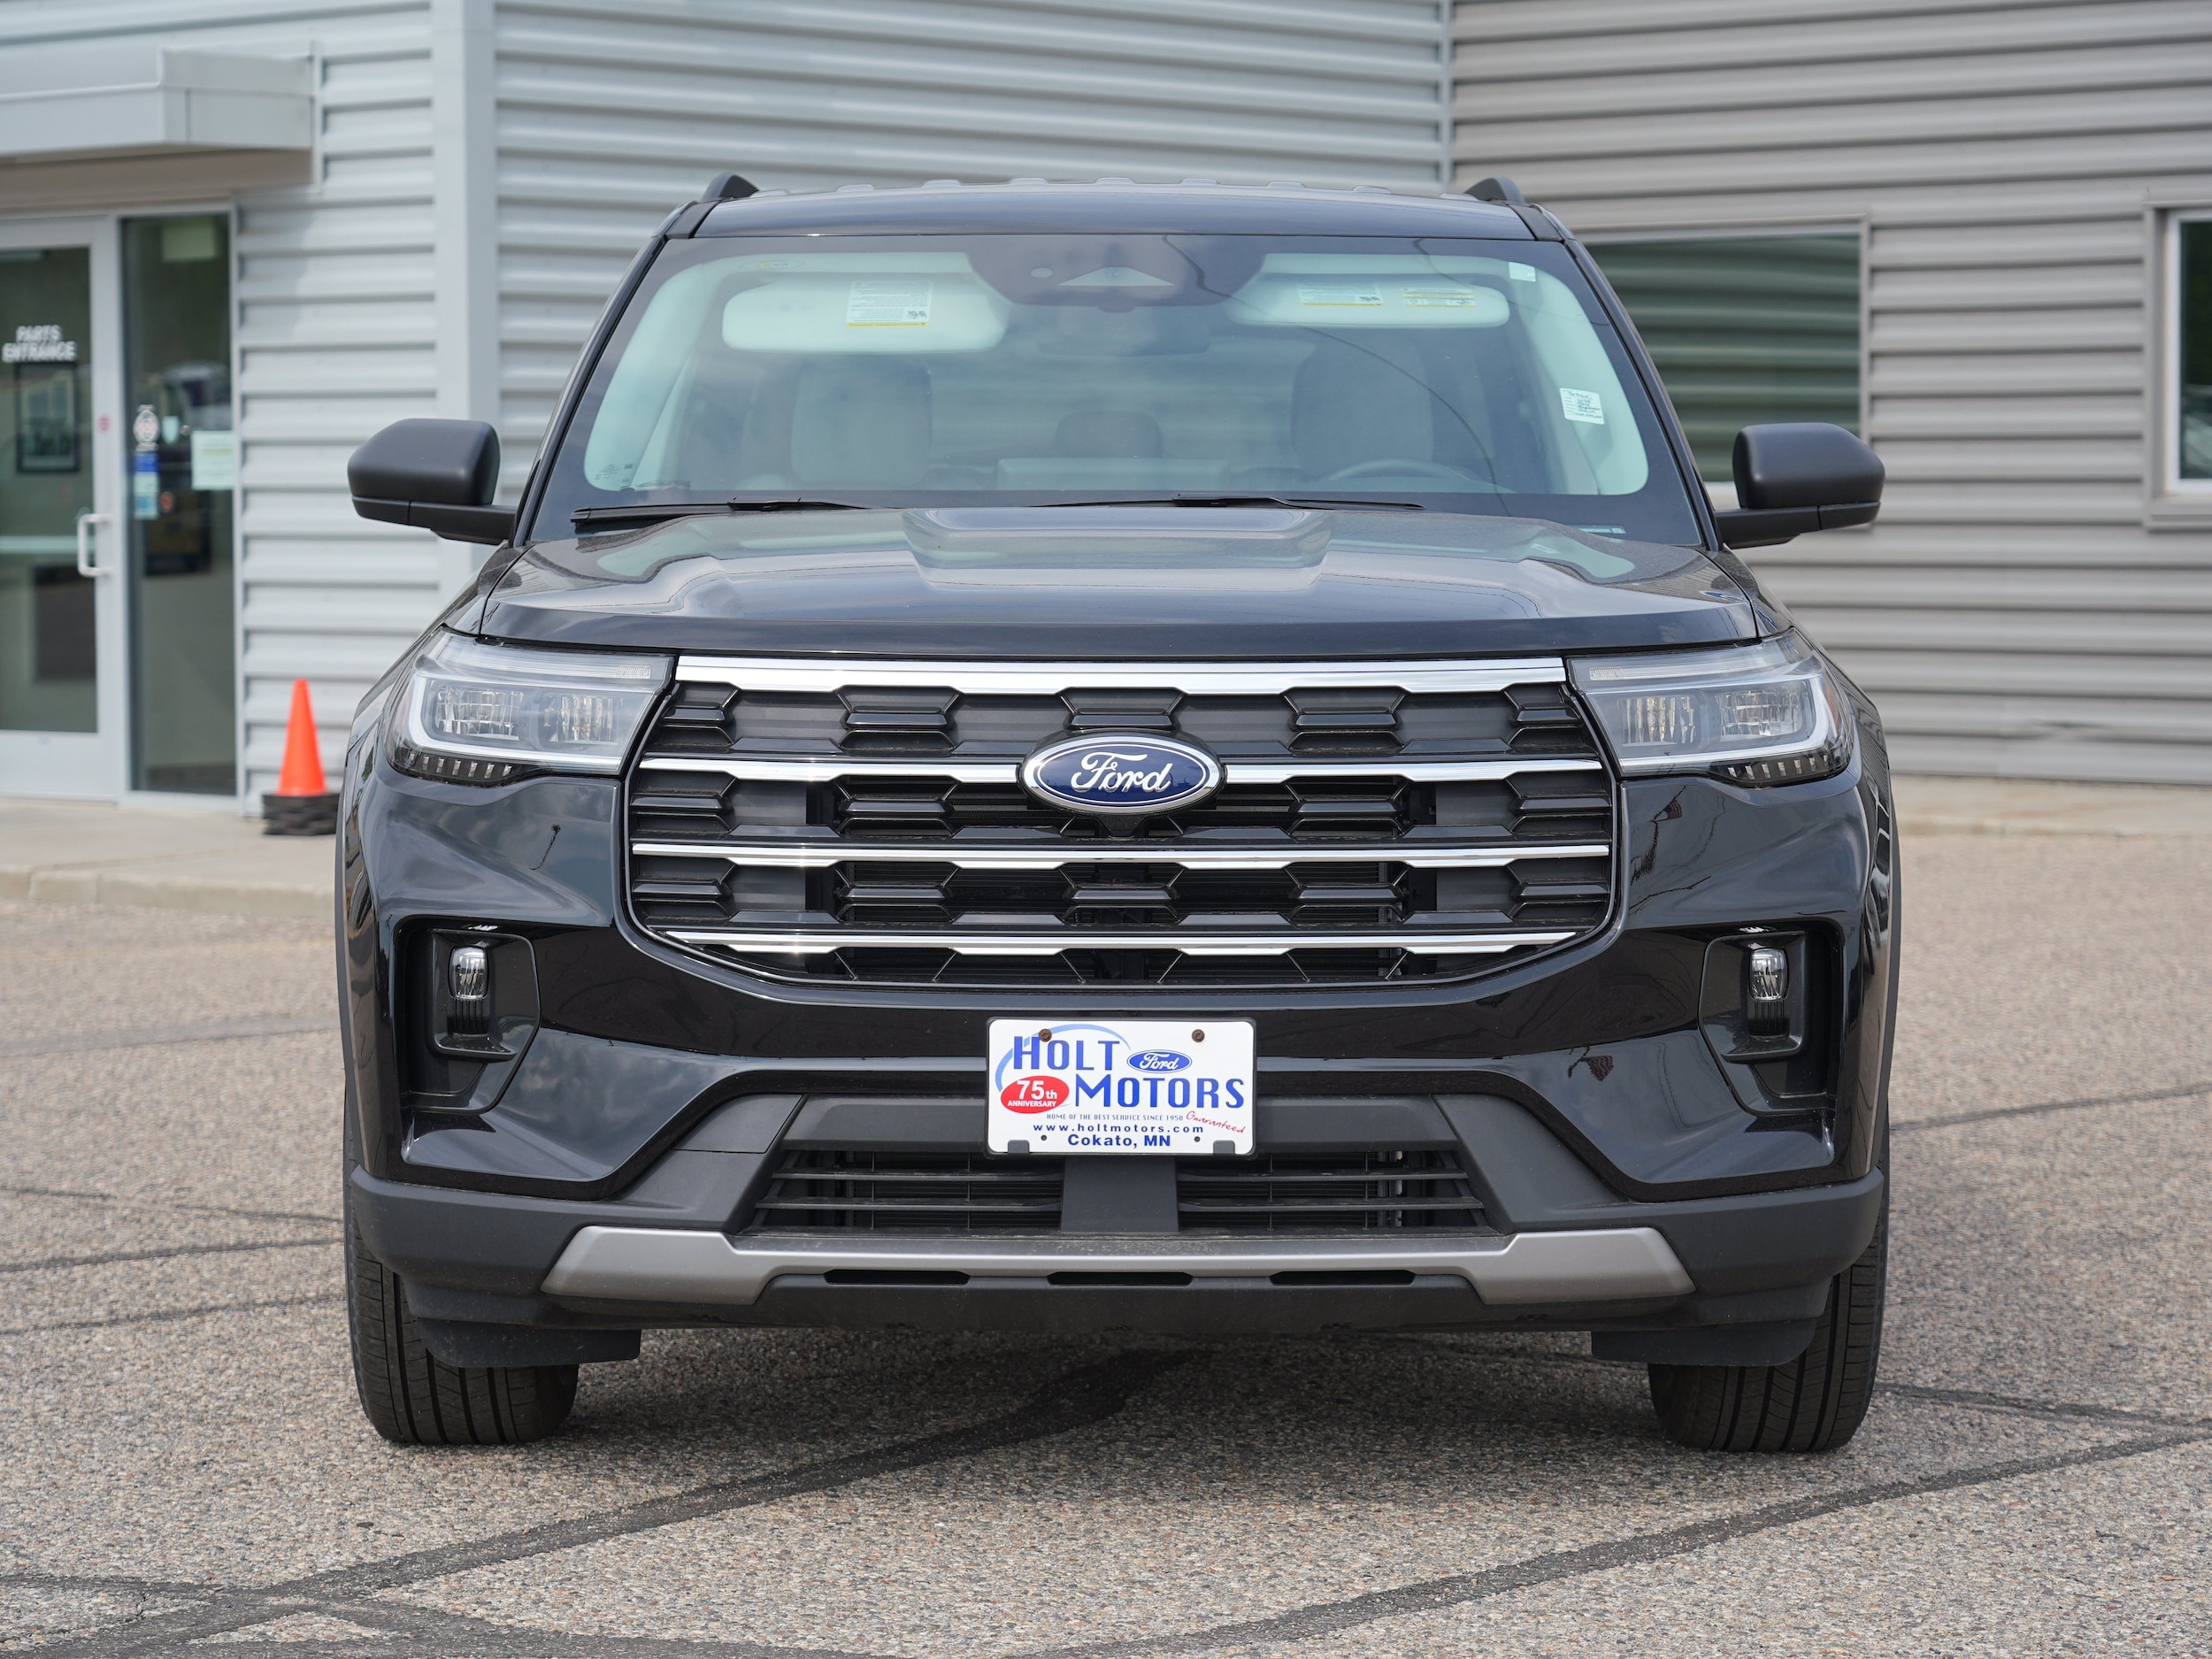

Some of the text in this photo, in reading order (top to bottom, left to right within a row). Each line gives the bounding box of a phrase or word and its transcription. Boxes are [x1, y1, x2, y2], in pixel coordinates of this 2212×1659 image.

[16, 325, 62, 342] PARTS
[2, 342, 77, 363] ENTRANCE
[1071, 751, 1173, 793] Ford
[1013, 1035, 1120, 1071] HOLT
[1139, 1052, 1180, 1070] Ford
[1016, 1079, 1058, 1100] 75th
[1075, 1073, 1245, 1109] MOTORS
[1033, 1123, 1203, 1133] www.holtmotors.com
[1186, 1110, 1246, 1133] Guaranteed
[1067, 1133, 1171, 1148] Cokato, MN
